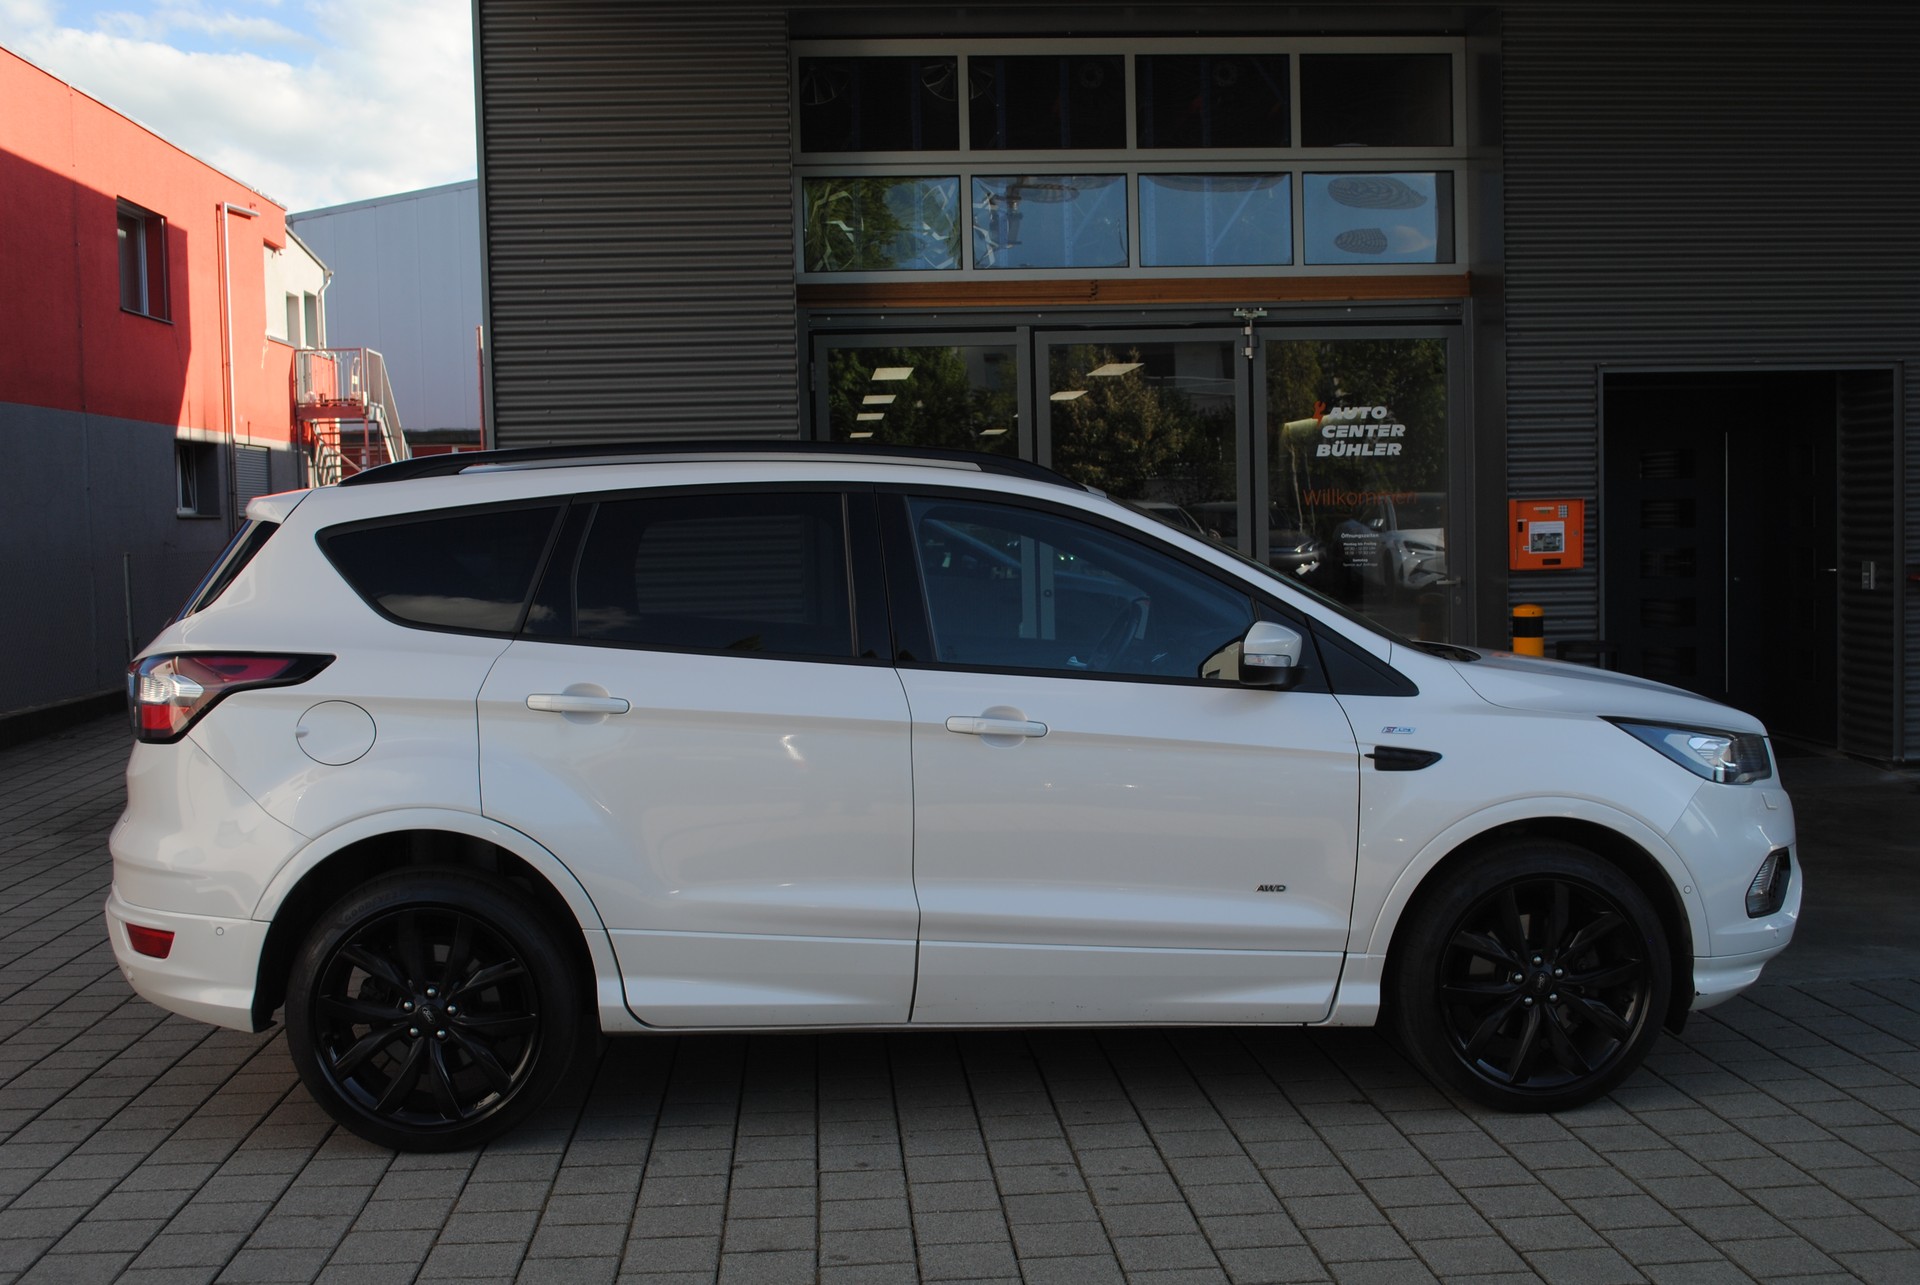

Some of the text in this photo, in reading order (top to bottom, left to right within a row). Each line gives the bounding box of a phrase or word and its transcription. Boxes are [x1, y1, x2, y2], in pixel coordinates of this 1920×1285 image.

[1329, 406, 1388, 420] AUTO
[1321, 424, 1406, 438] CENTER
[1316, 440, 1402, 457] BÜHLER
[1302, 488, 1417, 506] Willkommen
[1256, 884, 1286, 892] AWD
